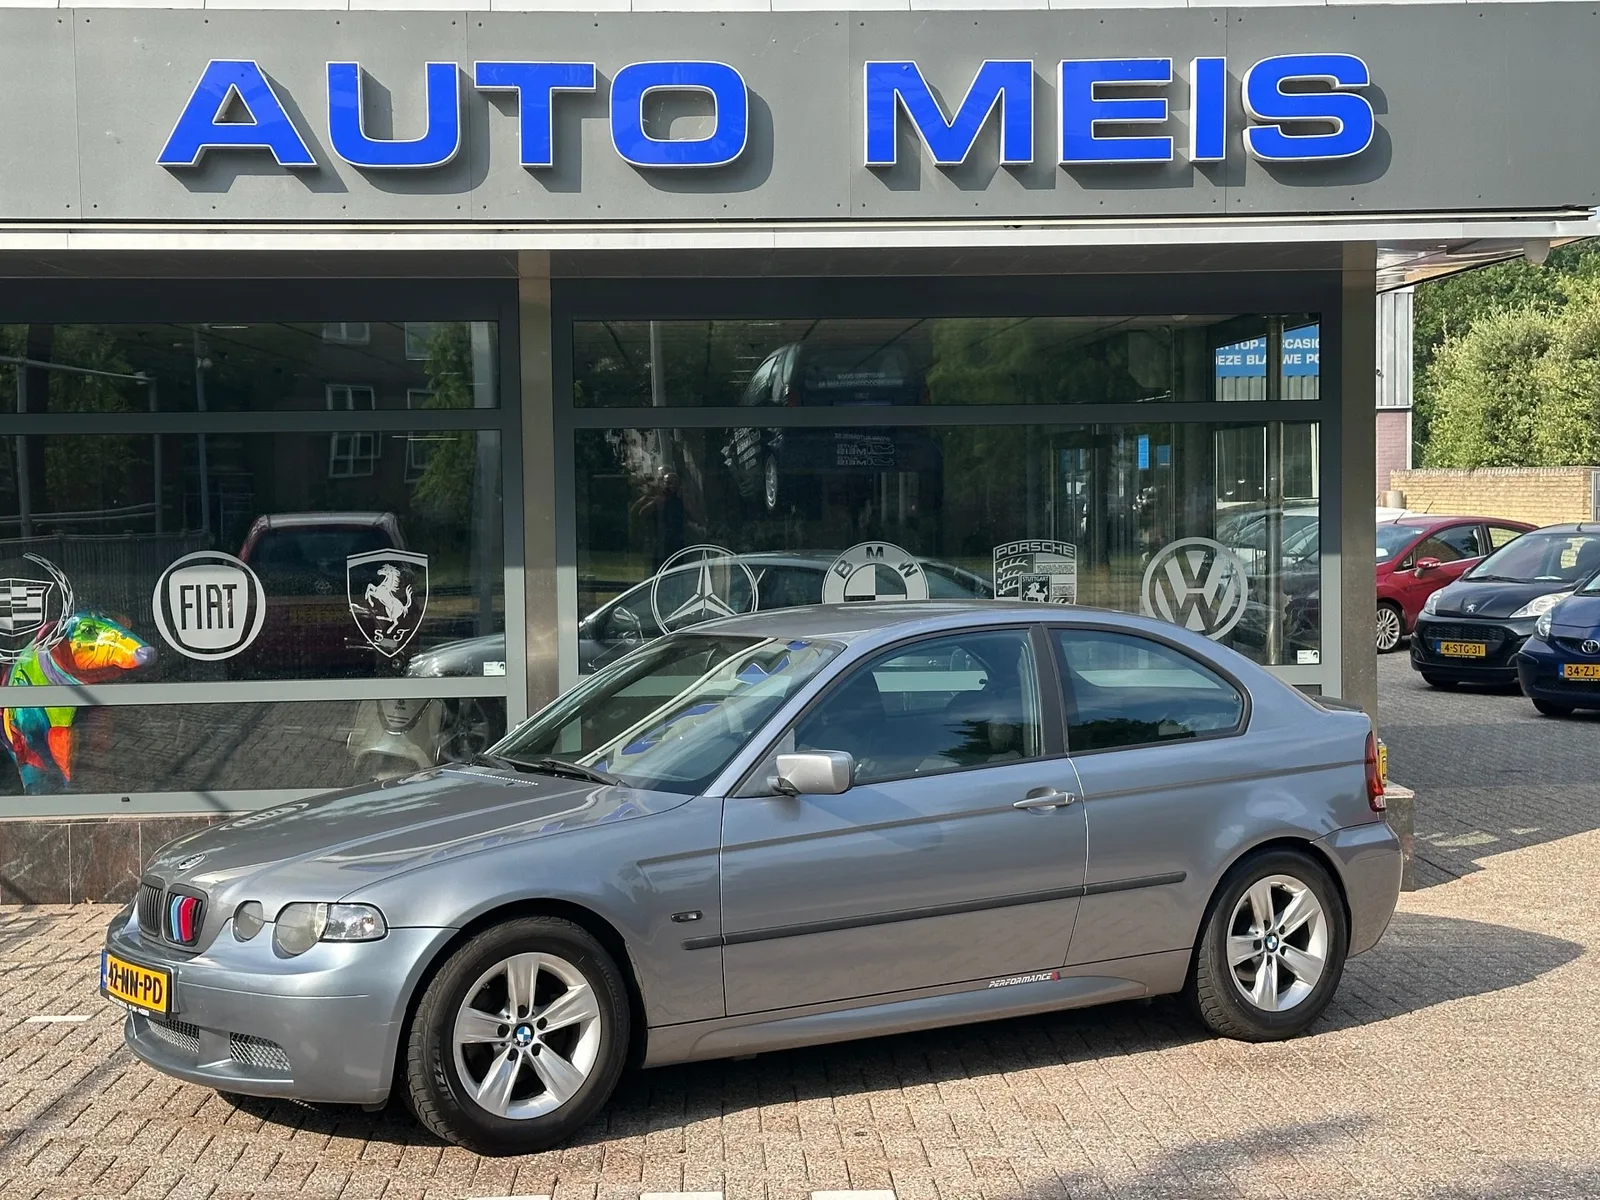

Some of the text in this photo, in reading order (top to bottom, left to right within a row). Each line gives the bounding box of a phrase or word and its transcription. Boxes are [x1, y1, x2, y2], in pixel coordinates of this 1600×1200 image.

[159, 54, 1374, 166] AUTO MEIS
[833, 546, 918, 580] BMW
[996, 542, 1075, 559] PORSCHE
[1022, 575, 1049, 583] STUTTGART
[179, 583, 238, 630] FIAT
[1444, 645, 1482, 654] 4-STG-31
[108, 961, 163, 1005] 42-NN-PD
[988, 972, 1053, 988] PERFORMANCE
